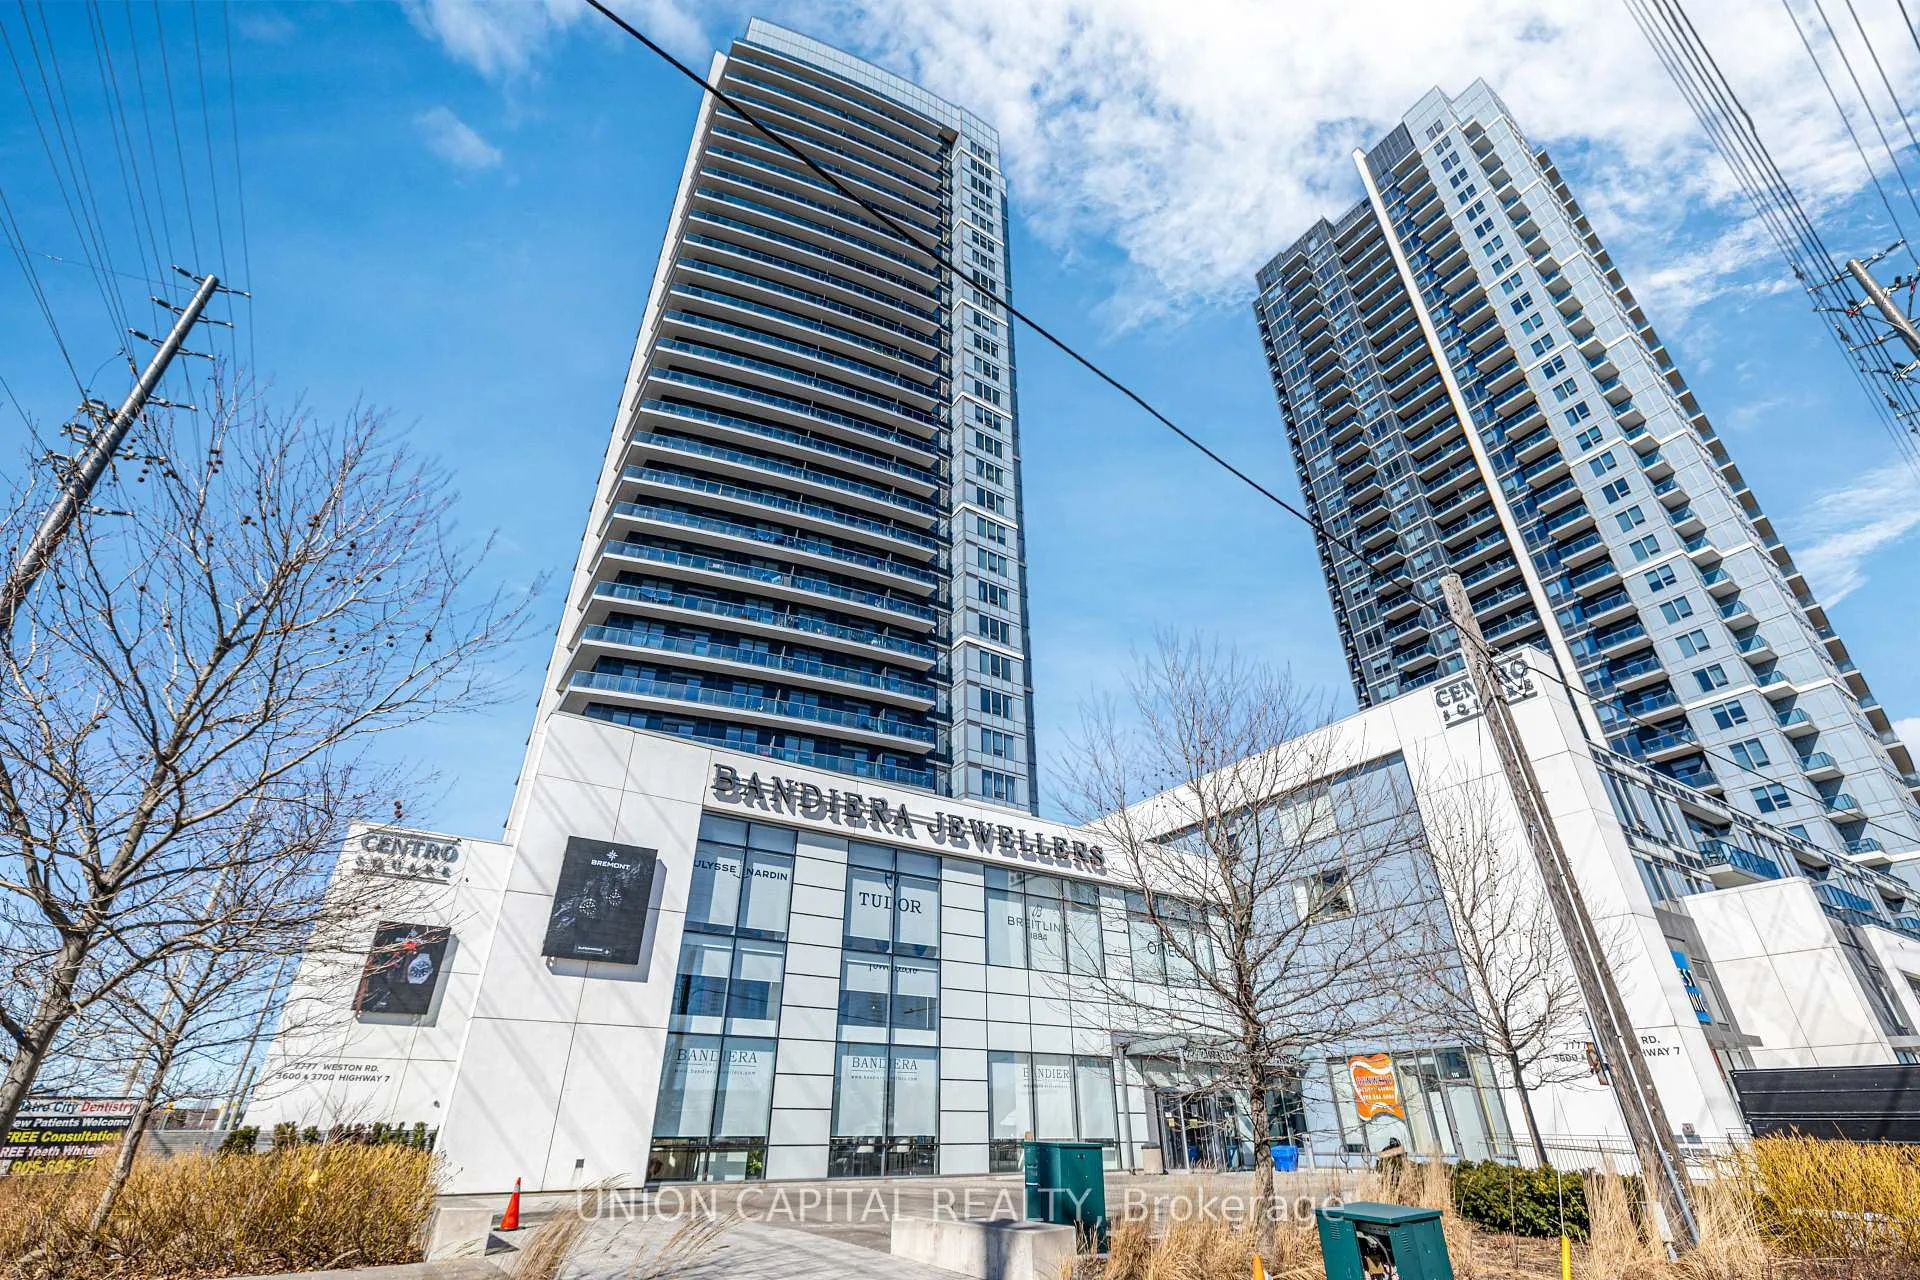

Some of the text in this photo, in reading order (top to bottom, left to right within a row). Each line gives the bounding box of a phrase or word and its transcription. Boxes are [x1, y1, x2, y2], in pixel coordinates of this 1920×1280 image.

[1436, 659, 1528, 708] CENO
[711, 763, 1106, 868] BANDIERA JEWELLERS
[361, 834, 459, 863] CENTRO
[591, 859, 631, 870] BREMONT
[694, 860, 788, 881] ULYSSE NARDIN
[859, 891, 922, 914] TUDOR
[1030, 931, 1048, 941] 1884
[1641, 1036, 1661, 1045] RD.
[1673, 1046, 1680, 1055] 7
[323, 1063, 362, 1071] WESTON
[852, 1056, 918, 1071] BANDERA
[311, 1073, 335, 1081] 3700
[338, 1074, 381, 1082] HIGHWAY
[1023, 1067, 1071, 1080] BNDIER
[53, 1101, 77, 1114] City
[80, 1101, 135, 1113] Dentistry
[33, 1118, 79, 1127] Patients
[82, 1117, 130, 1126] Welcome
[41, 1131, 120, 1142] Consultation
[0, 1146, 26, 1158] REE
[28, 1146, 60, 1157] Teeth
